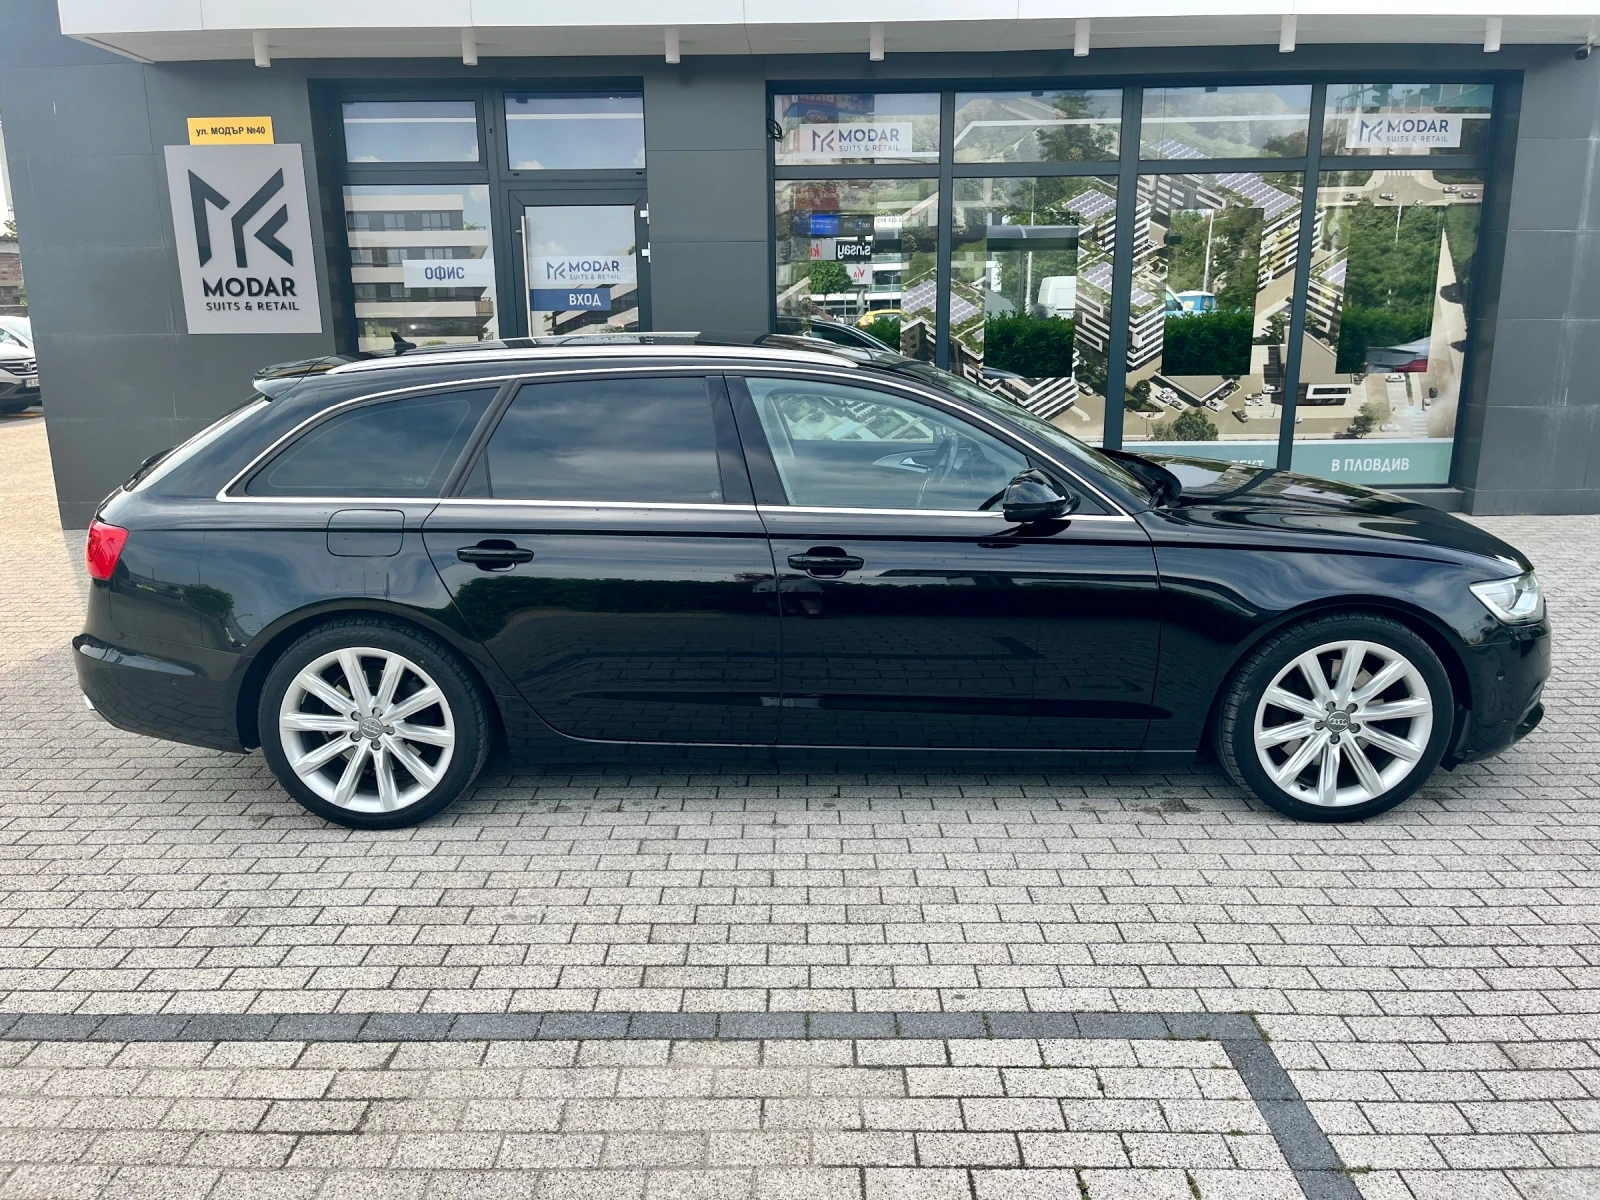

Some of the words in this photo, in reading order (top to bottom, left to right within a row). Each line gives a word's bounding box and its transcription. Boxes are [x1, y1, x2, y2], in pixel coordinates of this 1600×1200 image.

[196, 128, 209, 137] ул.
[211, 126, 244, 136] МОДЪР
[246, 126, 266, 135] №40
[1387, 119, 1449, 133] MODAR
[838, 128, 900, 142] MODAR
[1386, 135, 1409, 143] SUITS
[1411, 135, 1417, 143] &
[872, 144, 900, 152] RETAIL
[424, 265, 465, 281] ОФИС
[568, 260, 620, 272] MODAR
[202, 276, 297, 297] MODAR
[206, 301, 241, 311] SUITS
[244, 301, 253, 311] &
[257, 301, 300, 311] RETAIL
[568, 293, 602, 307] ВХОД
[1331, 458, 1340, 472] В
[1344, 457, 1410, 473] ПЛОВДИВ
